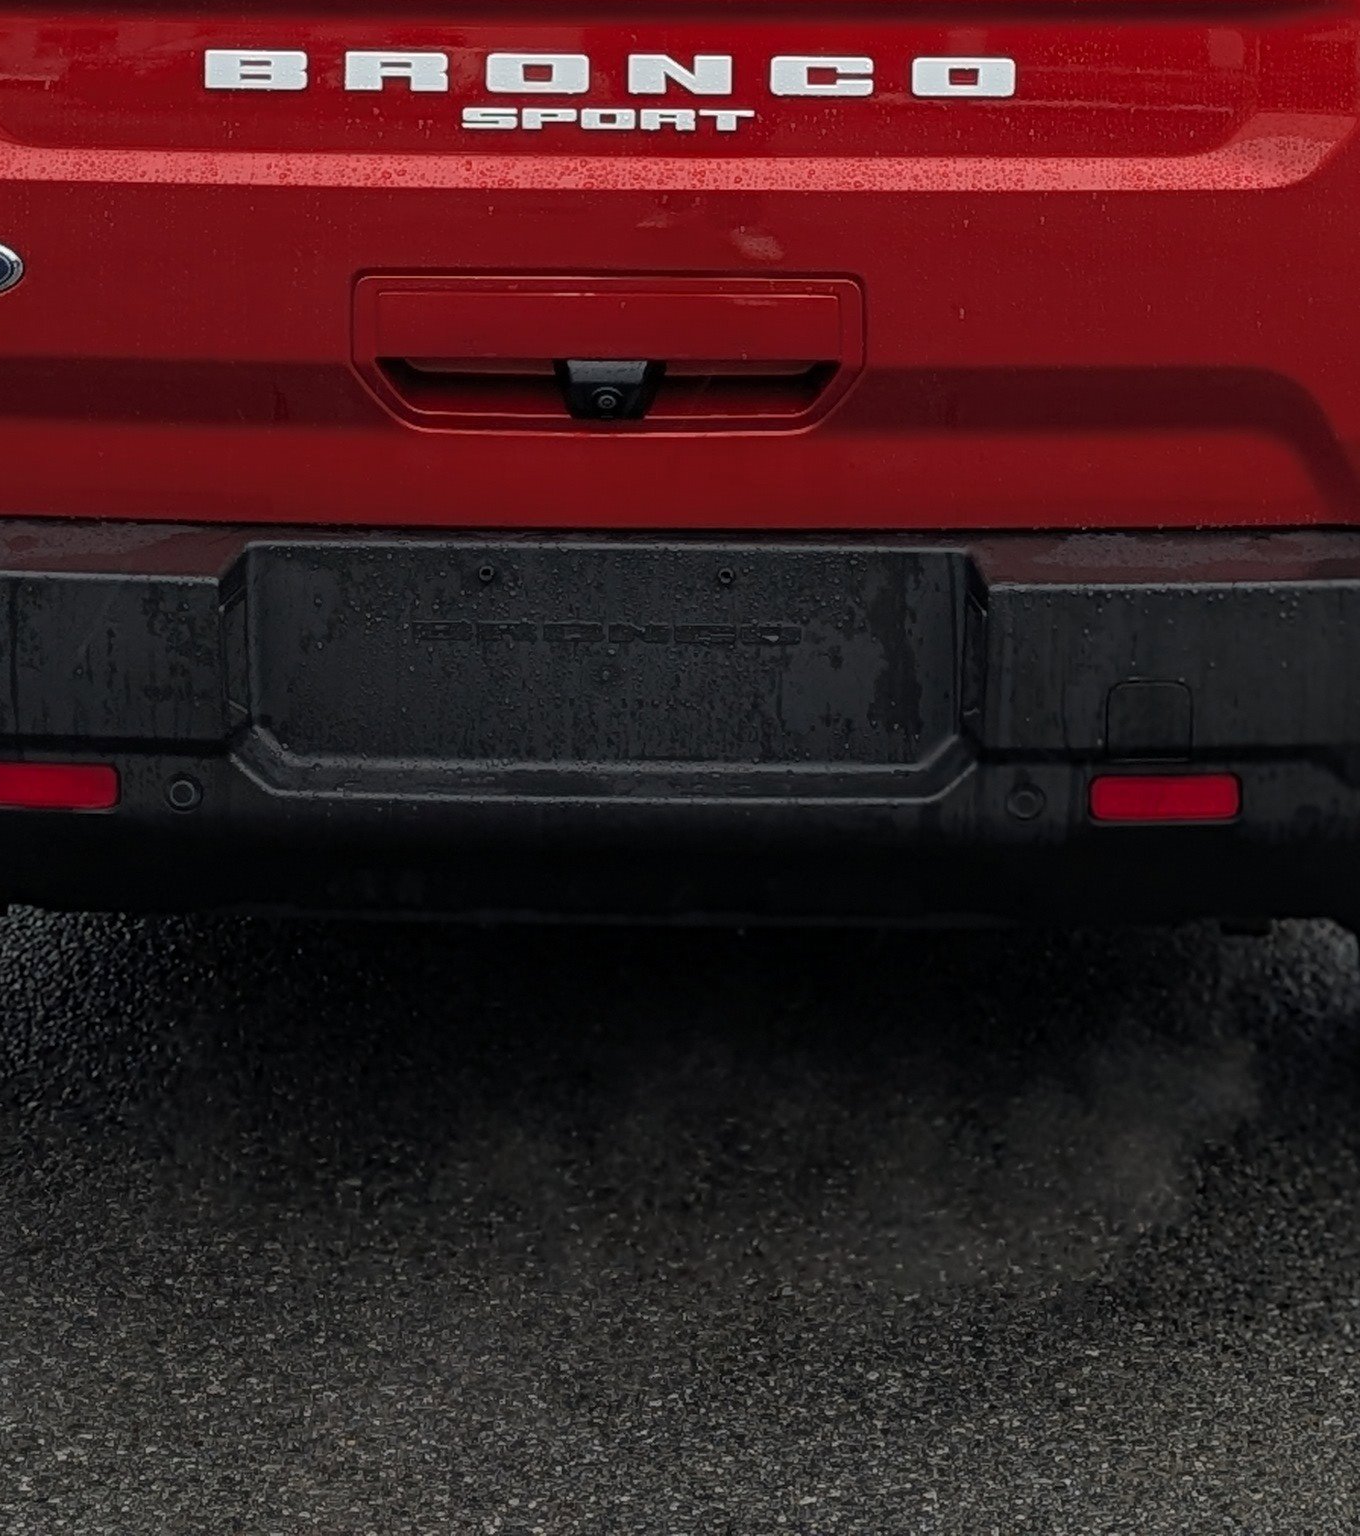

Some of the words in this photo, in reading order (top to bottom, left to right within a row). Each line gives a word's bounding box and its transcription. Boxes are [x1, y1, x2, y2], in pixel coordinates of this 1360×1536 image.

[204, 48, 1017, 98] BRONCO
[460, 106, 756, 133] SPORT
[411, 619, 803, 646] BRONCO
